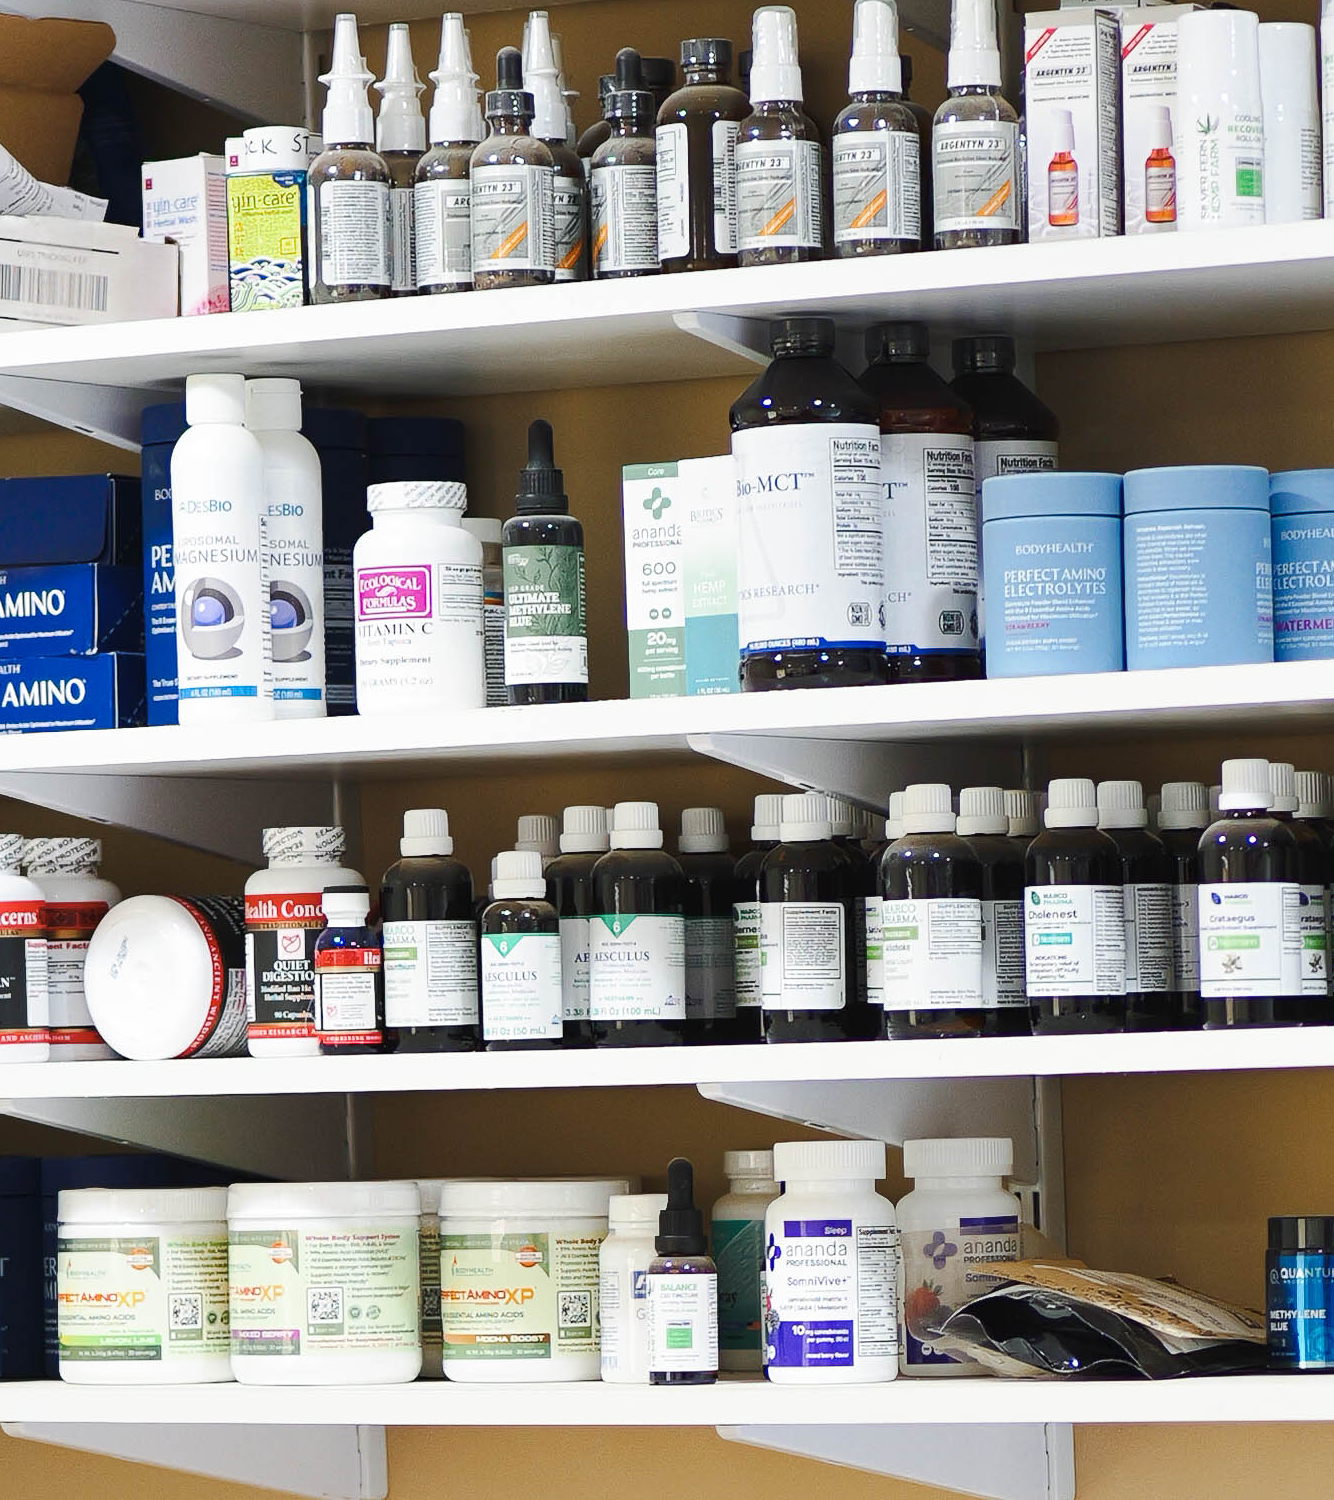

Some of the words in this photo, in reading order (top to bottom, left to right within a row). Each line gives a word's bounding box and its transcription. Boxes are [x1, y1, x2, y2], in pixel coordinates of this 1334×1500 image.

[940, 139, 985, 152] ARGENTYN
[988, 138, 1001, 150] 23
[1015, 543, 1092, 555] BODYHEALTH
[642, 561, 676, 576] 600
[752, 584, 815, 598] RESEARCH
[1004, 582, 1106, 597] ELECTROLYTES
[508, 592, 560, 604] ULTIMATE
[508, 604, 572, 616] METHYLENE
[421, 621, 433, 635] C
[508, 616, 533, 628] BLUE
[2, 678, 86, 708] AMINO
[1028, 908, 1078, 920] Cholenest
[1210, 913, 1256, 924] Crataegus
[594, 951, 650, 963] AESCULUS
[273, 959, 310, 971] QUIET
[824, 1226, 847, 1237] Sleep
[785, 1241, 847, 1258] ananda
[963, 1240, 1017, 1255] ananda
[786, 1259, 847, 1267] PROFESSIONAL
[1270, 1309, 1326, 1319] METHYLENE
[1270, 1321, 1289, 1332] BLUE
